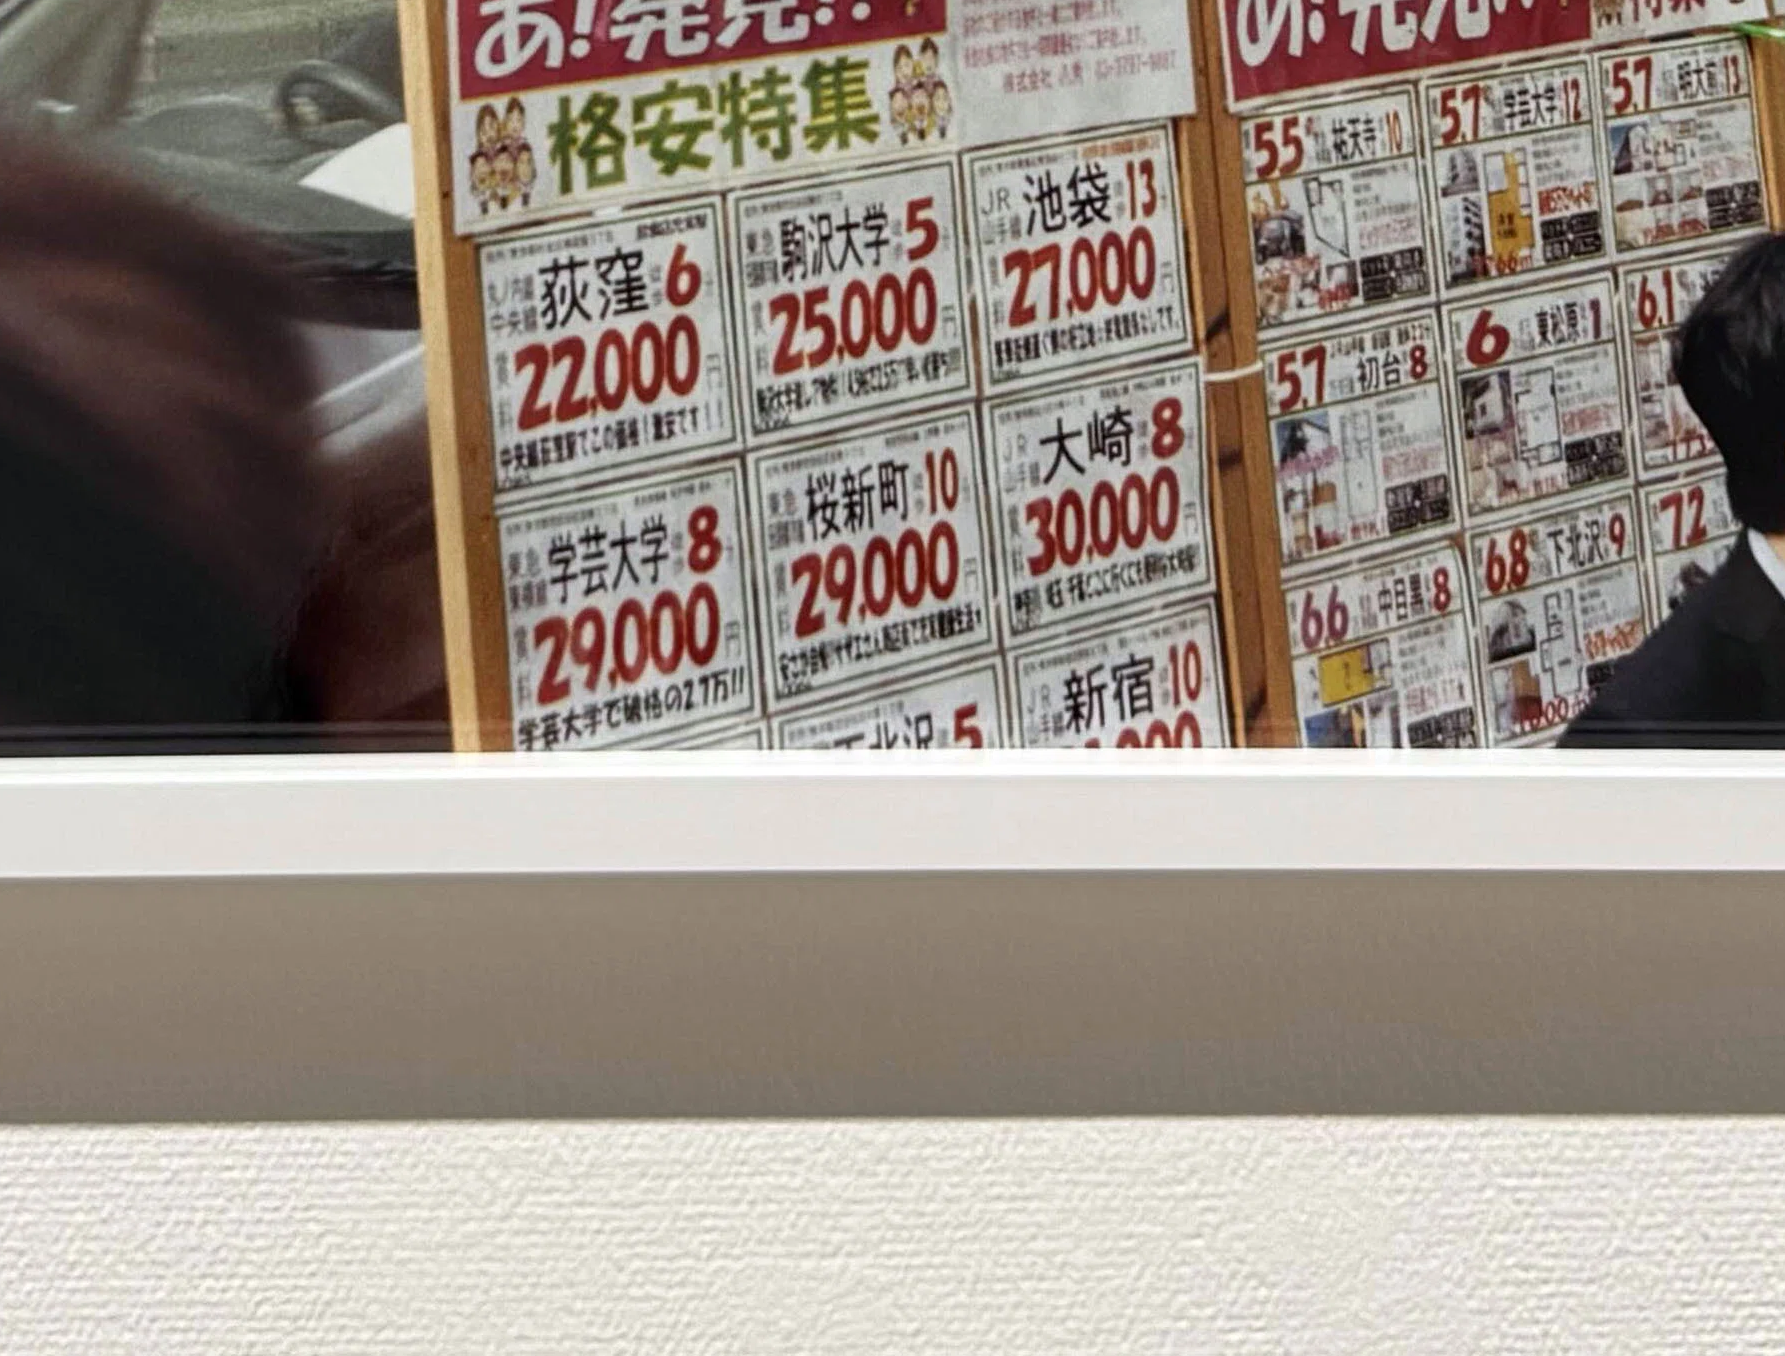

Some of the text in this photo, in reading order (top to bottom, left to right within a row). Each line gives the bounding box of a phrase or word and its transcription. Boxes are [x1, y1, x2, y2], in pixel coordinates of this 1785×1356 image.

[546, 56, 882, 195] 格安特集
[1385, 109, 1403, 154] 10
[1563, 78, 1582, 122] 12
[780, 202, 890, 283] 駒沢大学
[905, 195, 940, 262] 5
[981, 187, 1011, 216] JR
[1023, 158, 1157, 237] 池袋 13
[538, 248, 649, 331] 荻窪
[666, 242, 702, 308] 6
[769, 266, 938, 376] 25,000
[1003, 225, 1156, 330] 27,000
[514, 313, 701, 432] 22,000
[1357, 350, 1401, 393] 初台
[1409, 344, 1428, 380] 8
[1466, 309, 1510, 367] 6
[1039, 396, 1185, 486] 大崎 8
[805, 460, 909, 541] 桜新町
[925, 447, 959, 516] 10
[1025, 465, 1180, 577] 30,000
[548, 505, 723, 604] 学芸大学 8
[790, 520, 959, 639] 29,000
[1546, 518, 1604, 574] 下北沢
[1609, 512, 1626, 558] 9
[1377, 572, 1425, 626] 中目黒
[1433, 566, 1451, 613] 8
[533, 581, 721, 707] 29,000
[1063, 654, 1157, 736] 新宿
[1168, 639, 1202, 708] 10
